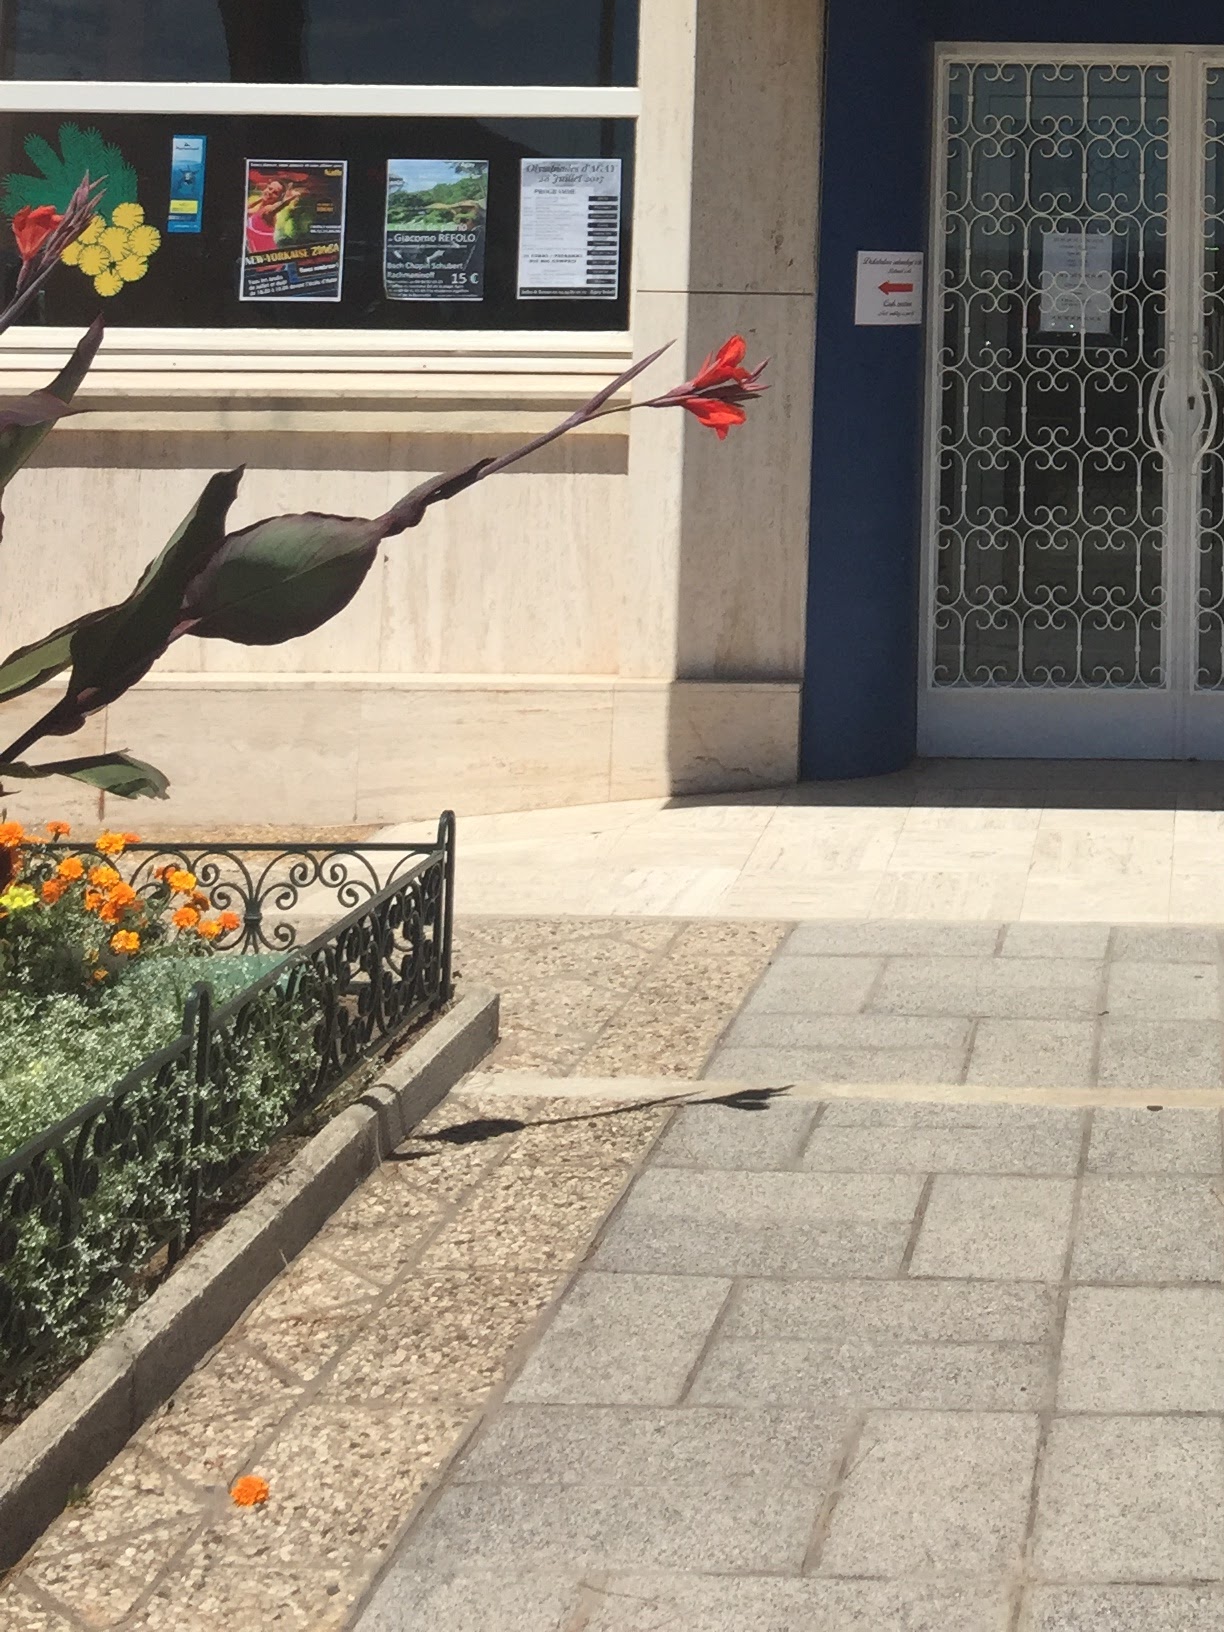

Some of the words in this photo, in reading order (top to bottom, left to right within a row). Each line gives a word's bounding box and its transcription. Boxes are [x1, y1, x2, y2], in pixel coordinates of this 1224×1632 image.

[393, 233, 437, 243] Giacomo
[438, 233, 476, 243] REFOLO
[451, 272, 468, 284] 15
[469, 272, 479, 284] €
